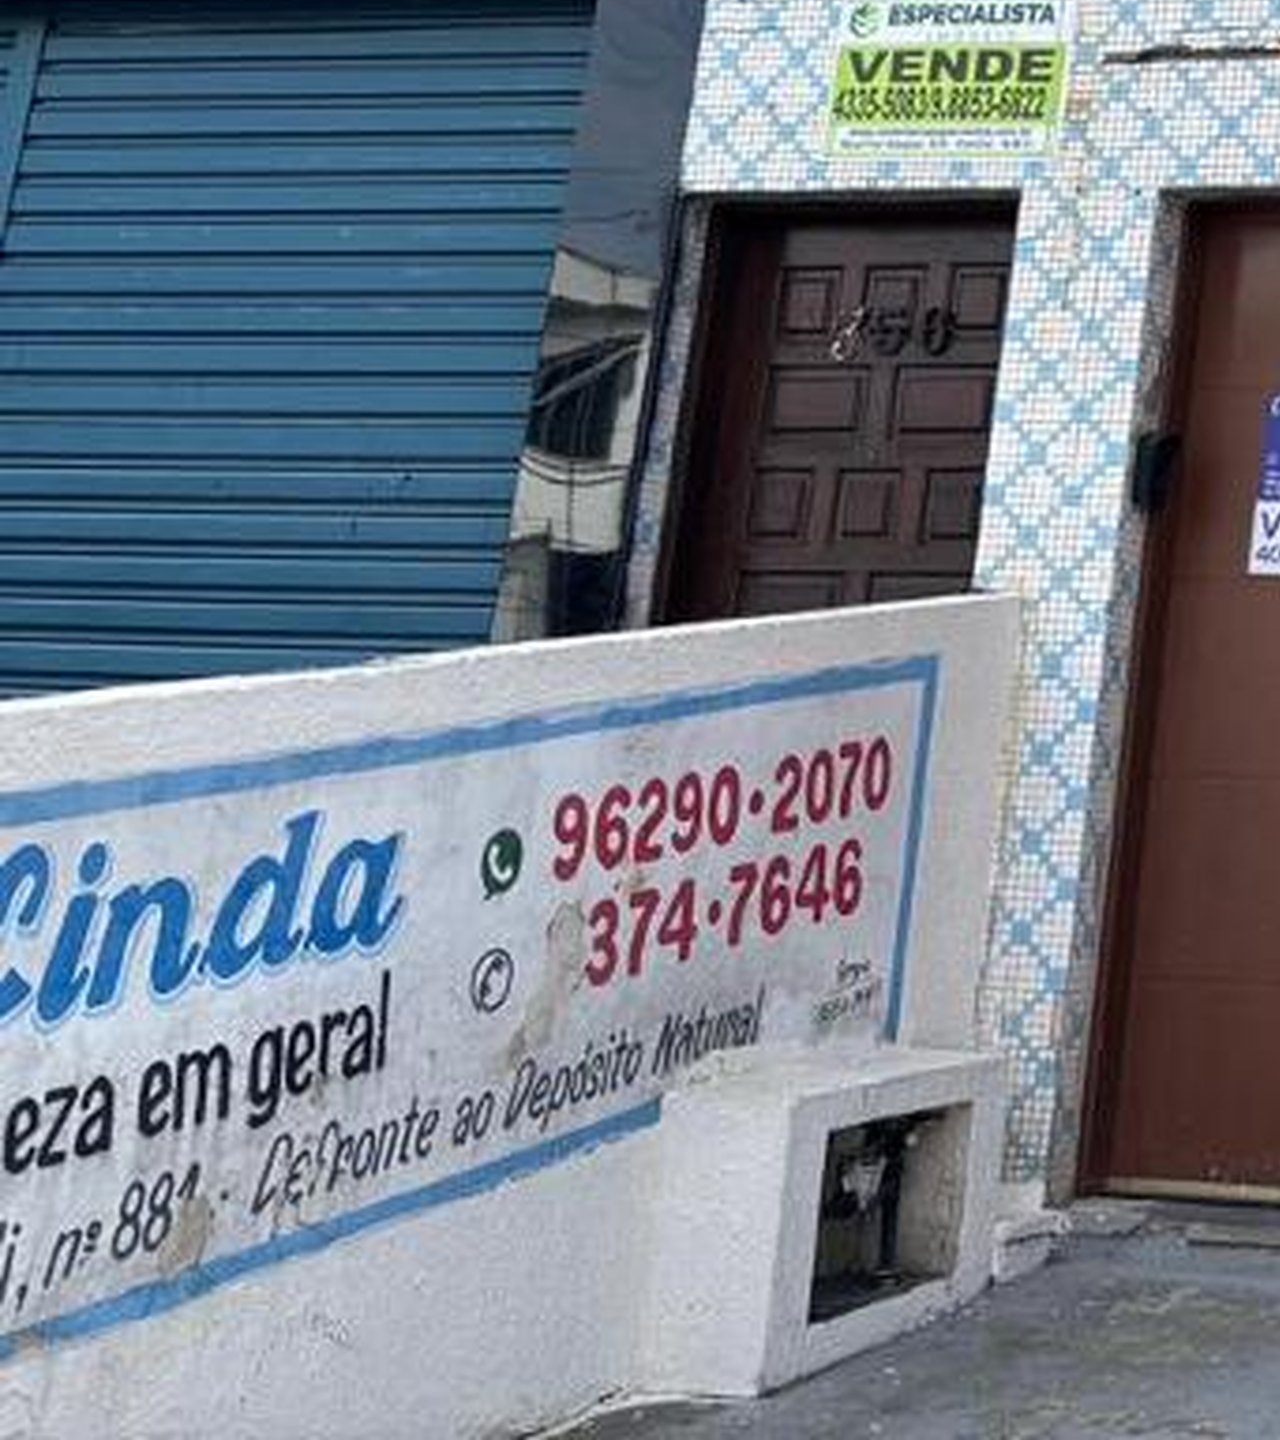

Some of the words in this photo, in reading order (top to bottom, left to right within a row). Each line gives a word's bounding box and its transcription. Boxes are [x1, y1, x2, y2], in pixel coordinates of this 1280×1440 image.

[888, 3, 1056, 26] ESPECIALISTA
[848, 49, 1056, 83] VENDE
[137, 1043, 233, 1138] em
[246, 970, 391, 1129] geral
[453, 1090, 495, 1146] ao
[503, 1029, 643, 1133] Depósito
